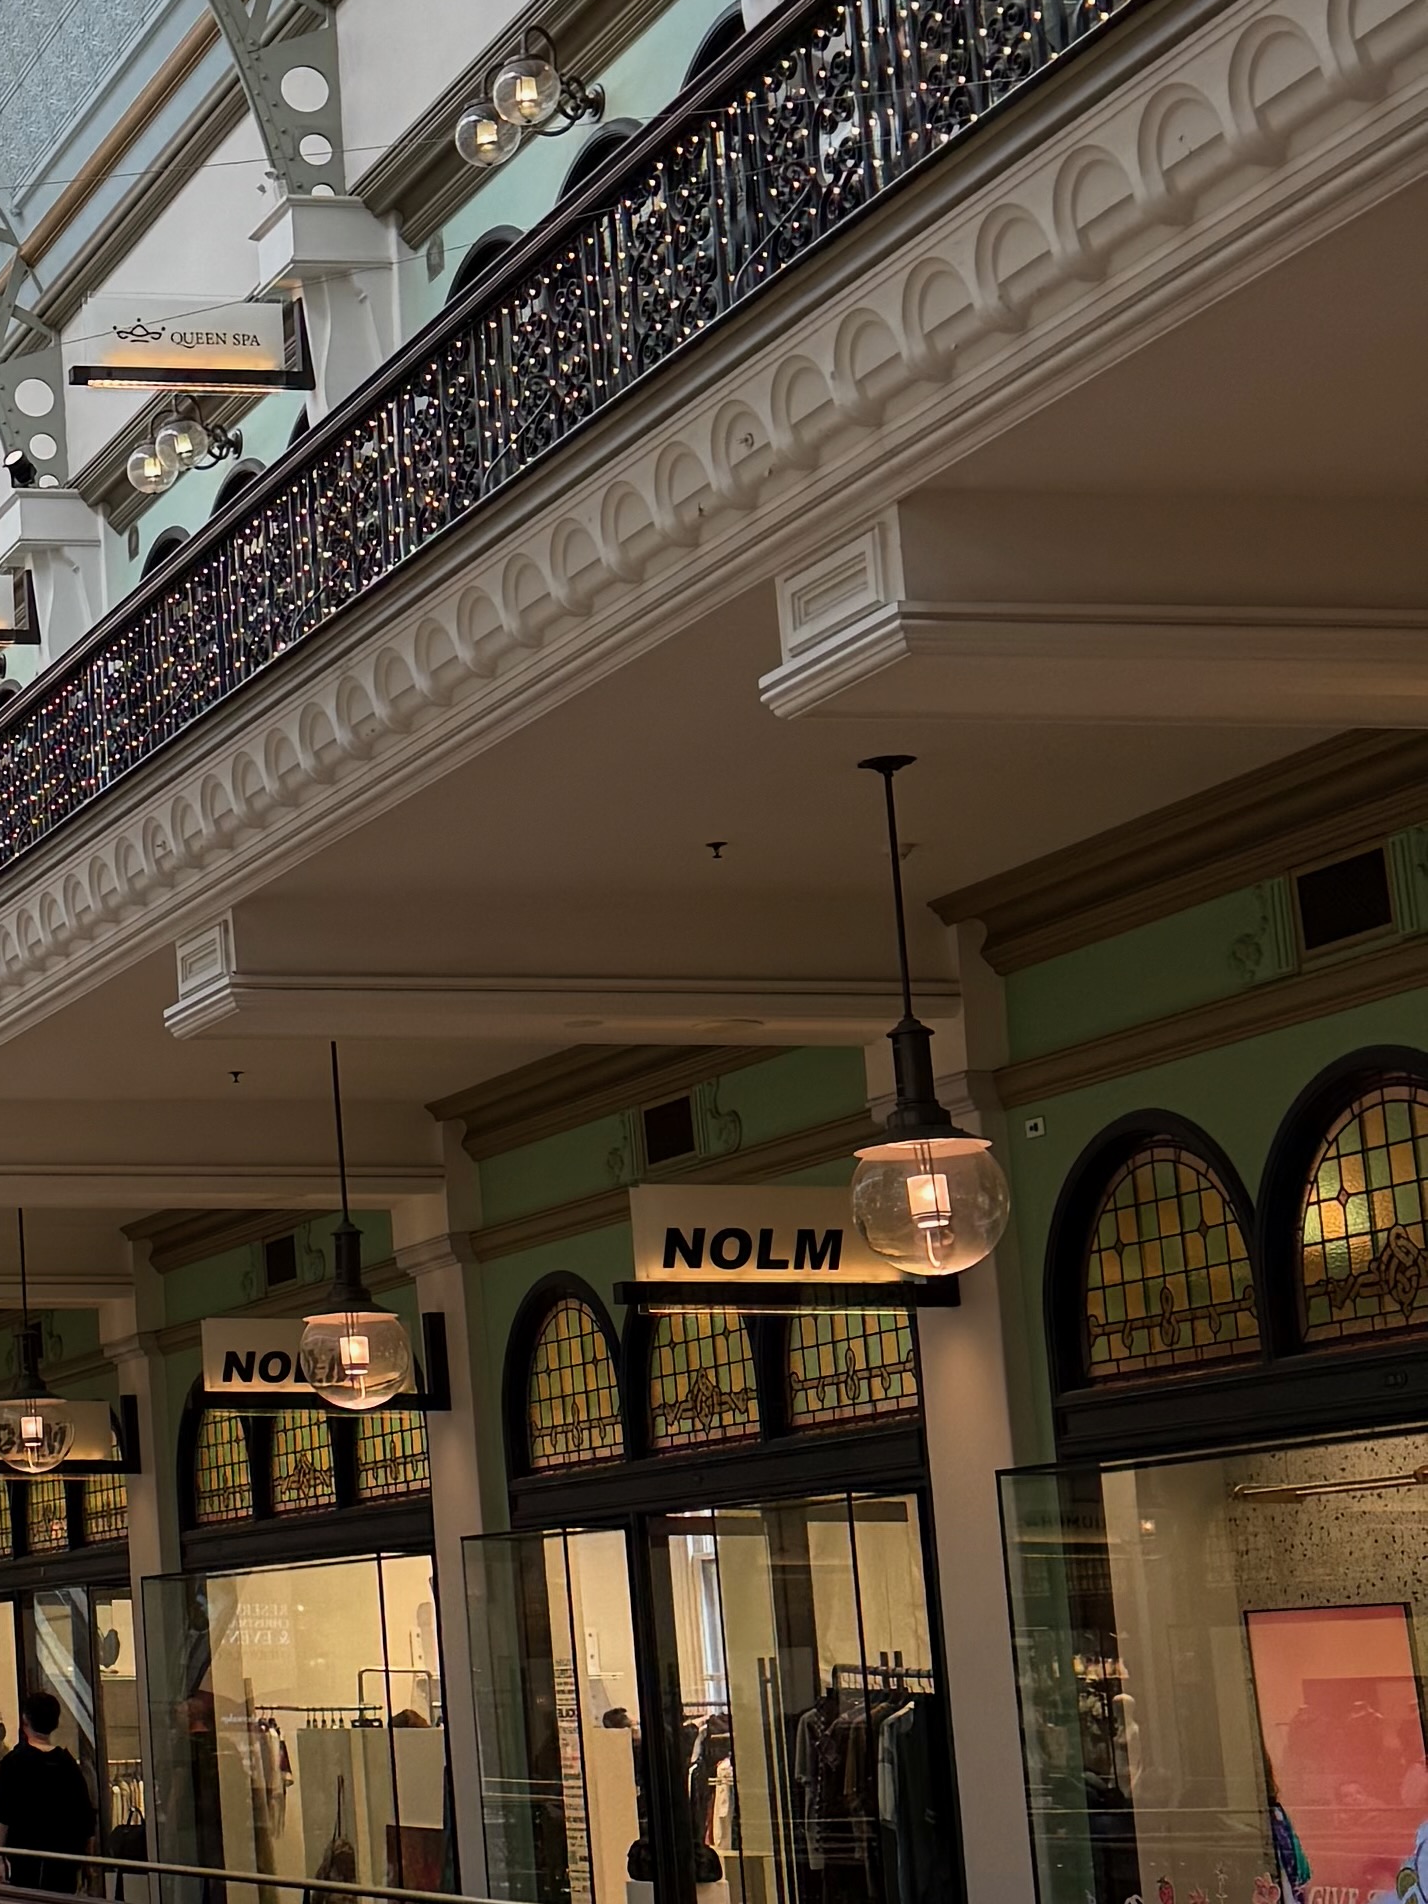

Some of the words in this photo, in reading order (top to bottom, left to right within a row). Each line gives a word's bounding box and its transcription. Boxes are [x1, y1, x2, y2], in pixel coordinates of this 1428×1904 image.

[170, 331, 227, 348] QUEEN
[232, 332, 261, 347] SPA
[661, 1226, 844, 1272] NOLM
